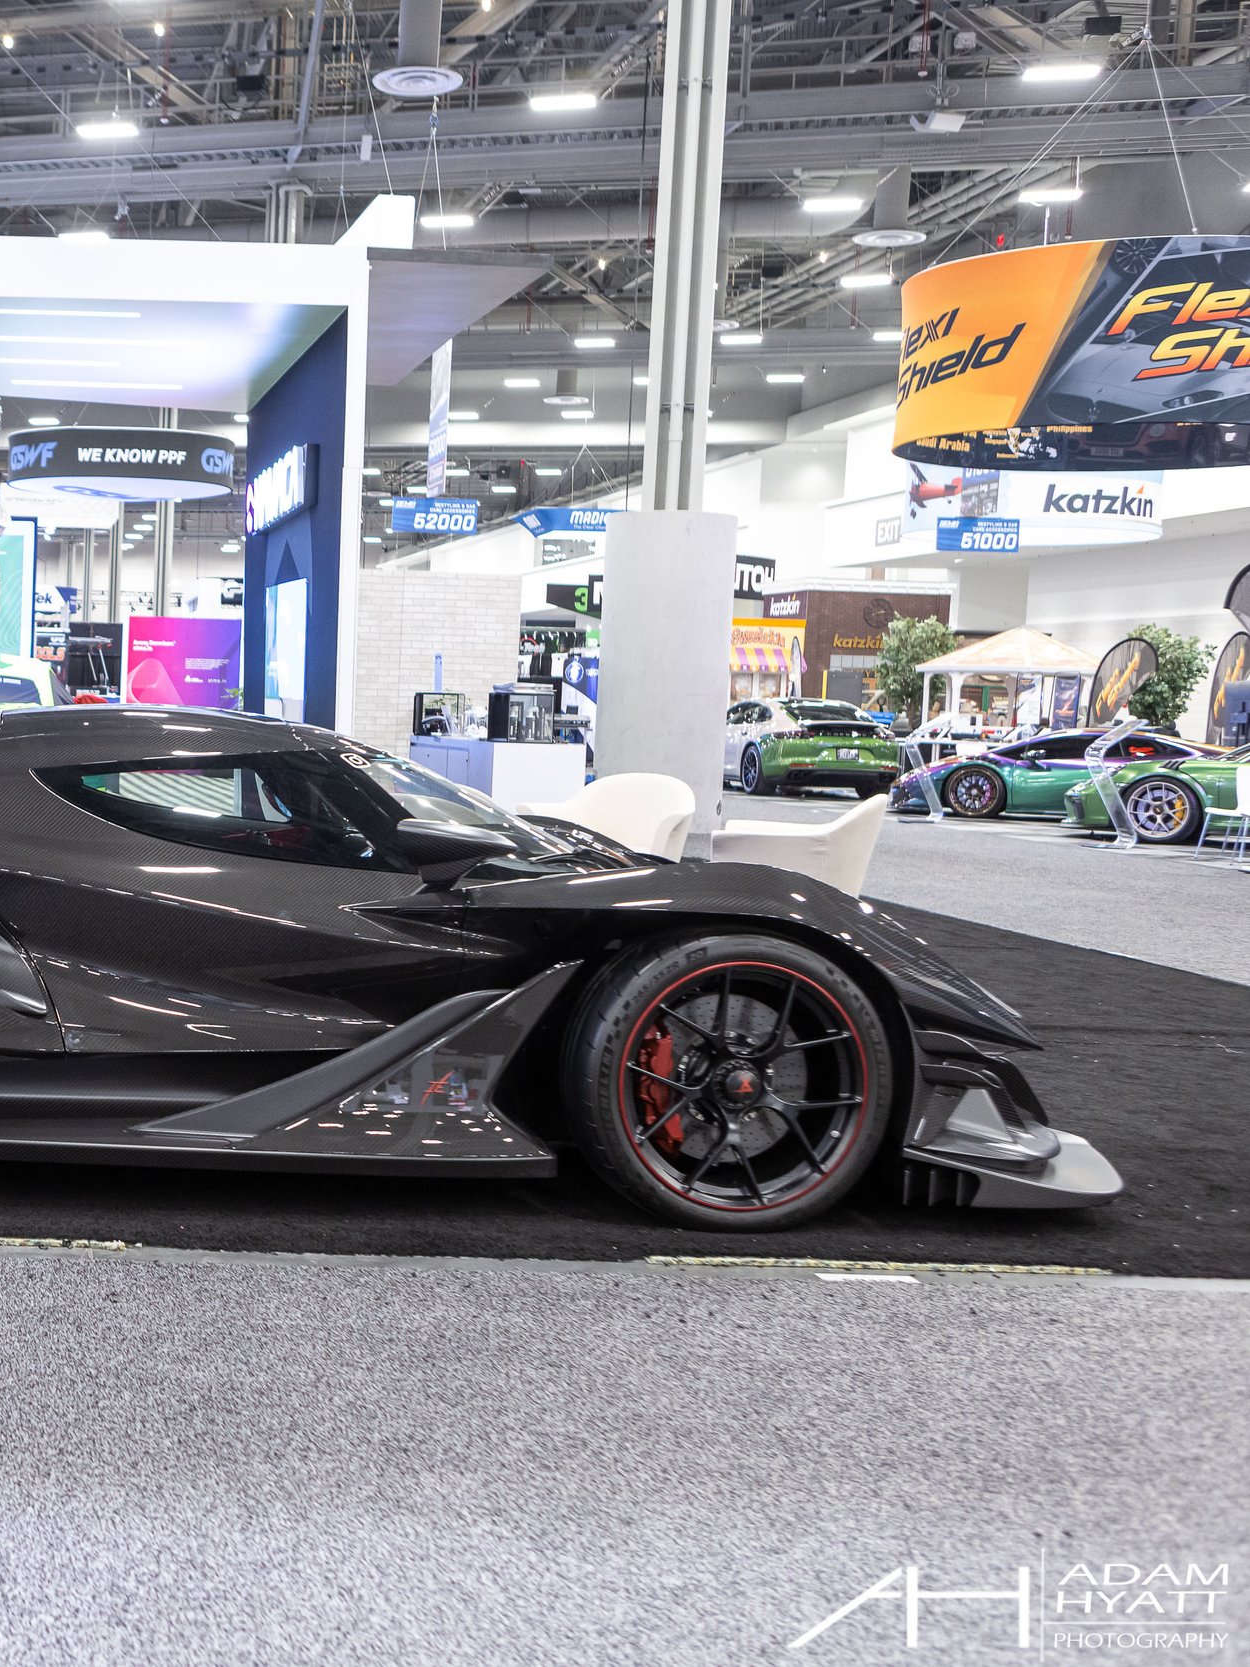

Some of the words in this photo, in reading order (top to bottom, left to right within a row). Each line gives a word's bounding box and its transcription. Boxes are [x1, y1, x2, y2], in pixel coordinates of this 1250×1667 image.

[1106, 281, 1250, 337] Fle
[896, 322, 1027, 411] Shield
[77, 447, 103, 462] WE
[104, 448, 156, 464] KNOW
[158, 450, 187, 465] PPF
[939, 438, 970, 452] Arabia
[1043, 484, 1153, 518] katzkin
[414, 512, 475, 531] 52000
[877, 520, 900, 543] EXIT
[961, 532, 1017, 550] 51000
[770, 593, 801, 616] katzkin
